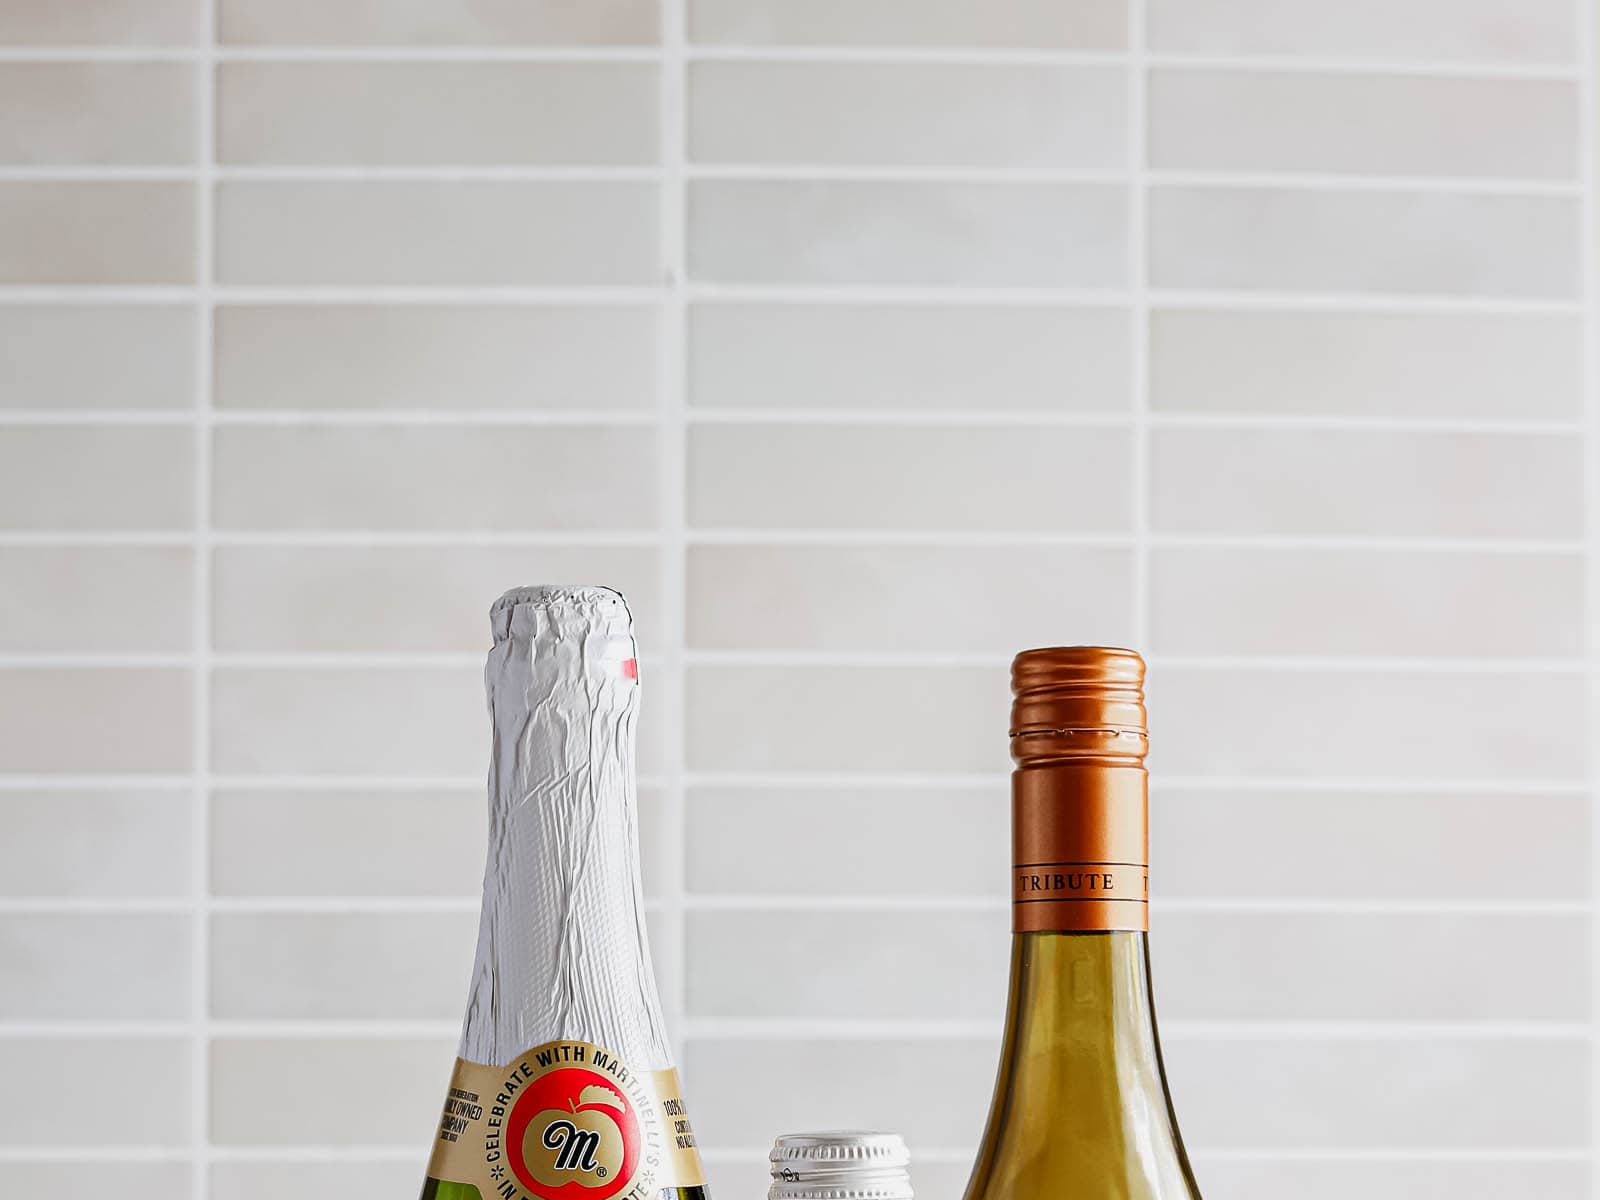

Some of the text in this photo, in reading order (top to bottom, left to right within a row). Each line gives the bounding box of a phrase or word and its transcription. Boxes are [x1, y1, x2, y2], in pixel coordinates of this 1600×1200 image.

[1020, 873, 1114, 892] TRIBUTE
[486, 1045, 660, 1167] CELEBRATE WITH MARTINELLI'S
[496, 1179, 516, 1200] IN
